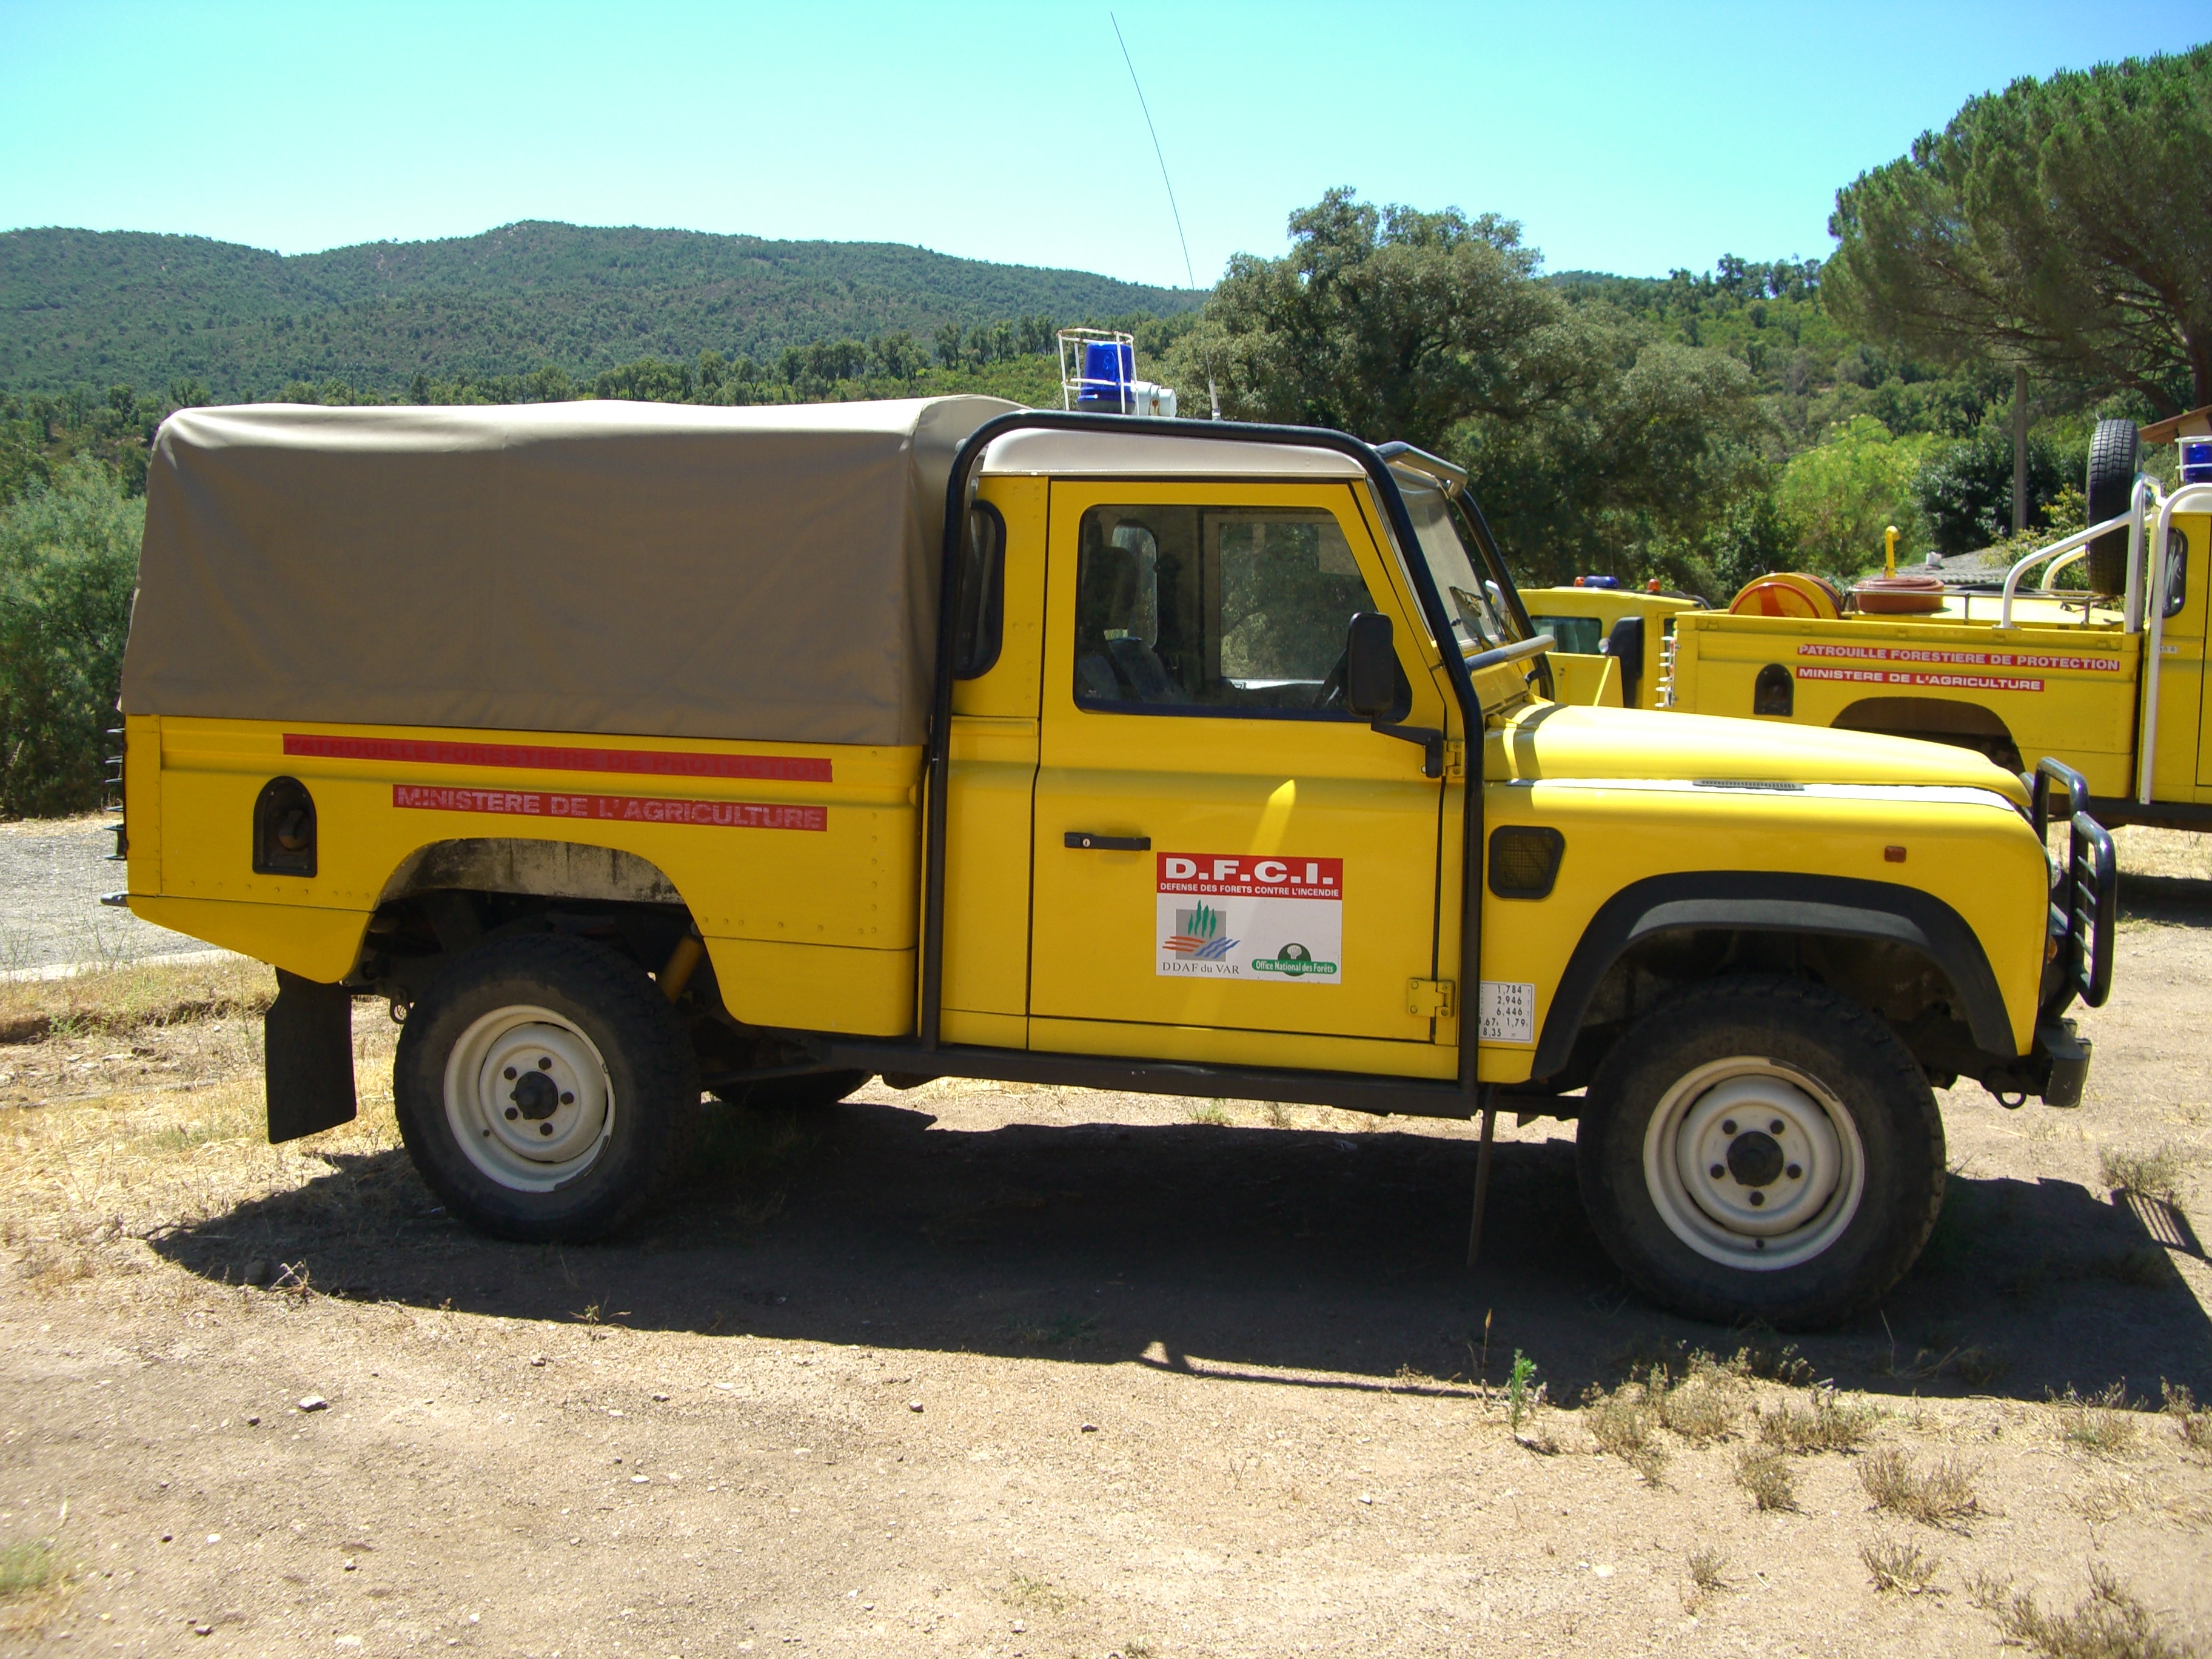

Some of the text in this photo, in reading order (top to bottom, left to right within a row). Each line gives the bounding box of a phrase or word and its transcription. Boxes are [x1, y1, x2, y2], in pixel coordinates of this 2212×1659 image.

[1798, 645, 2119, 670] PATROUILLE FORESTIERE DE PROTECTION
[1799, 668, 2040, 690] MINISTERE DE L'AGRICULTURE
[397, 787, 822, 829] MINISTERE DE L'AGRICULTURE
[1165, 857, 1333, 885] D.F.C.I.
[1160, 882, 1339, 897] DEFENSE DES FORETS CONTRE L'INCENDIE
[1162, 962, 1239, 974] DDAF du VAR
[1255, 960, 1333, 974] Office National des Forêts
[1498, 985, 1522, 995] 1,784
[1497, 995, 1522, 1005] 2,946
[1496, 1007, 1523, 1017] 6,446
